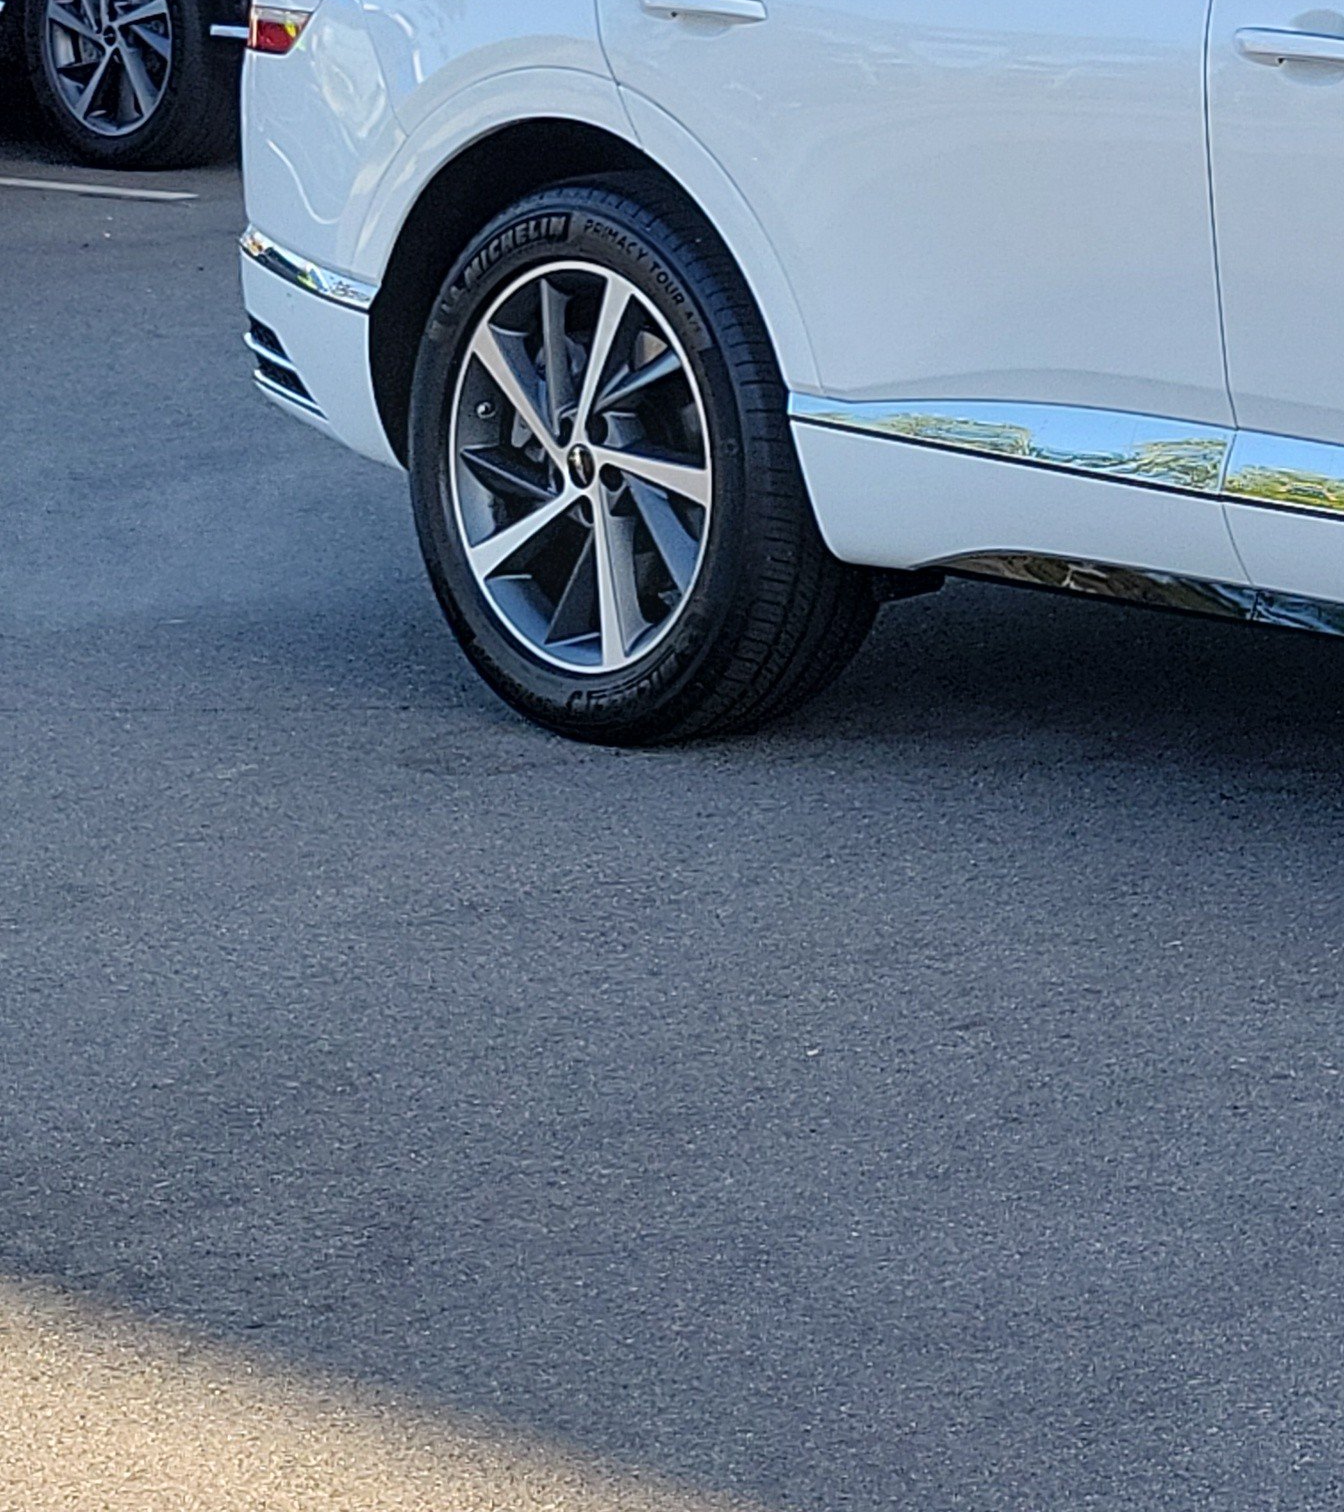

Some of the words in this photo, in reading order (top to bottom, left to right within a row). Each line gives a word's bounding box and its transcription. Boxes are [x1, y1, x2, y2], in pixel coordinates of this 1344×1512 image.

[464, 216, 567, 288] MICHELIN
[583, 219, 648, 262] PRIMACY
[650, 262, 685, 306] TOUR
